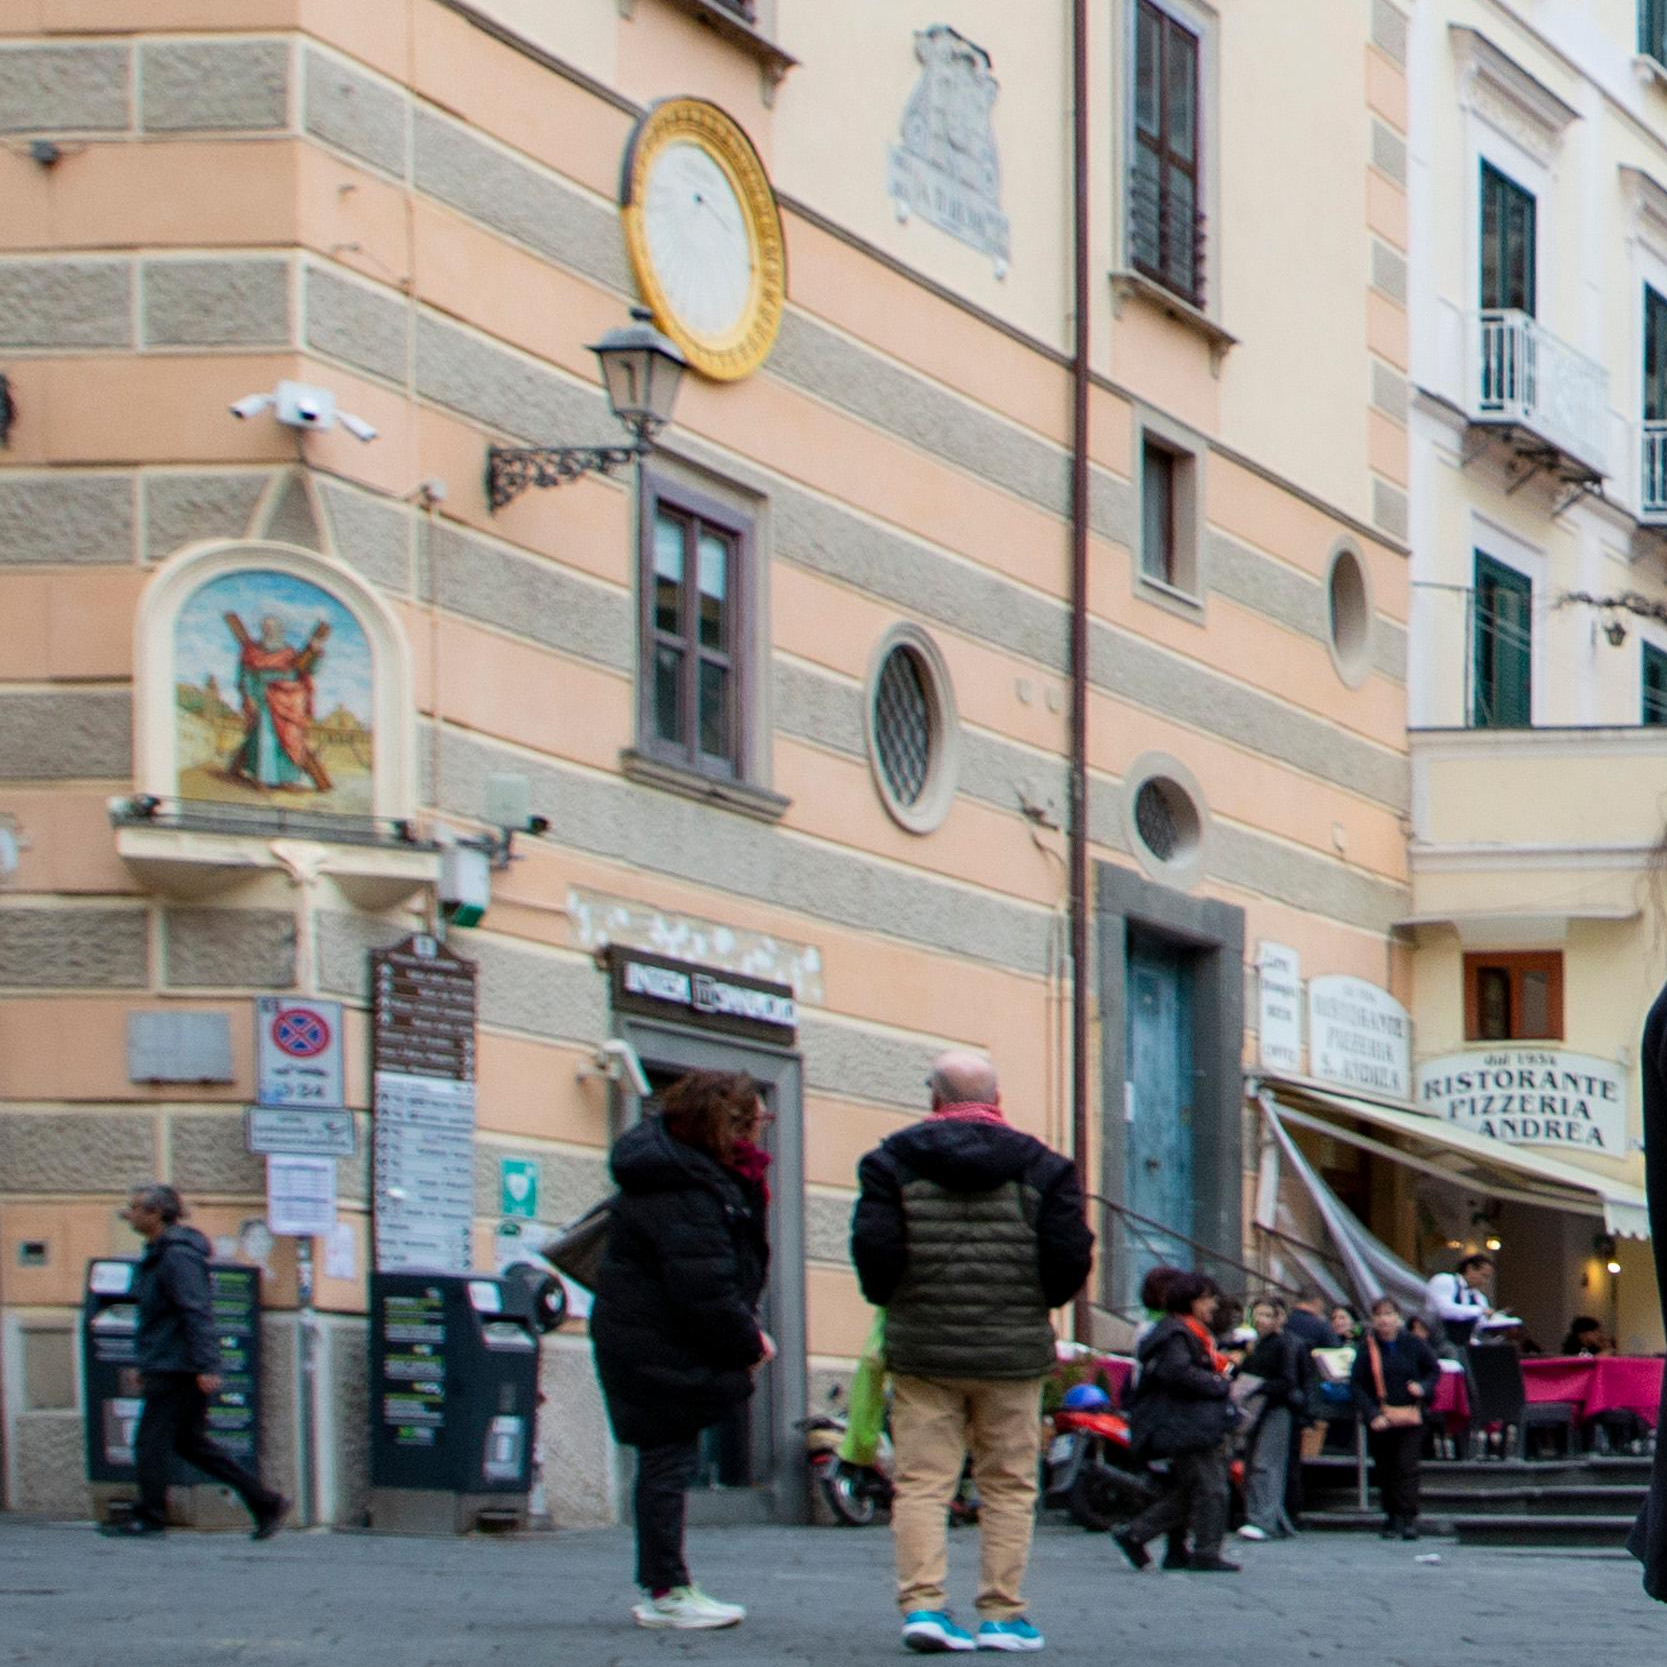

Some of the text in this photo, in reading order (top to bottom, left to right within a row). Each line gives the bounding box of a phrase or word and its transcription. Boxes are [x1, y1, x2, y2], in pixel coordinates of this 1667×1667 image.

[1423, 1069, 1619, 1102] RISTORANTE
[1449, 1095, 1592, 1120] PIZZERIA
[1479, 1118, 1606, 1147] ANDREA
